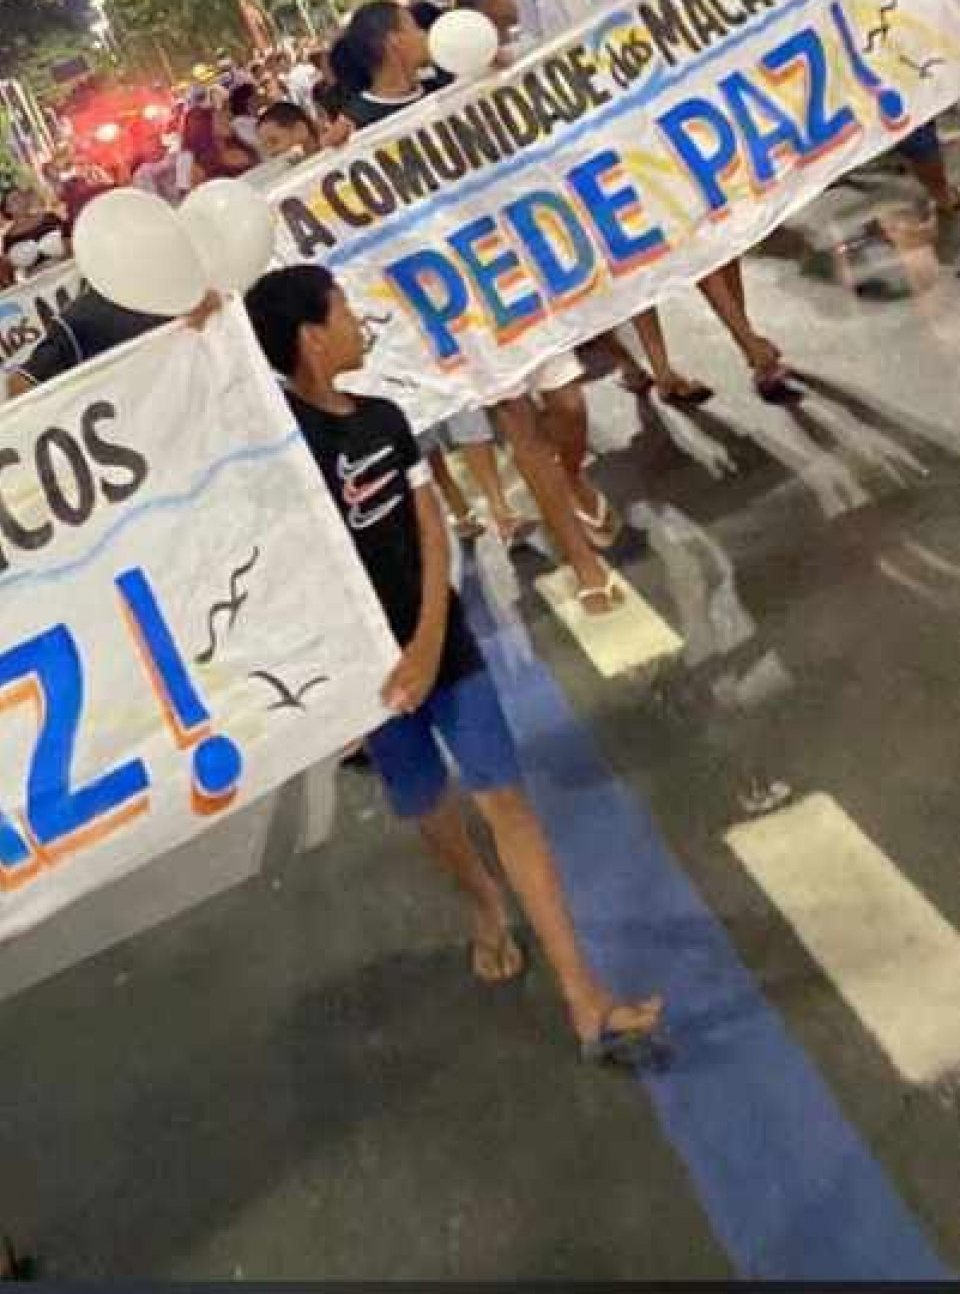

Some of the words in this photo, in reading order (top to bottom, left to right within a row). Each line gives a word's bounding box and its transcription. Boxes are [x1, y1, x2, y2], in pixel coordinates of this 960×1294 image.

[278, 196, 337, 257] A
[321, 44, 611, 227] COMUNIDADE
[385, 149, 669, 366] PEDE
[657, 0, 909, 218] PAZ!
